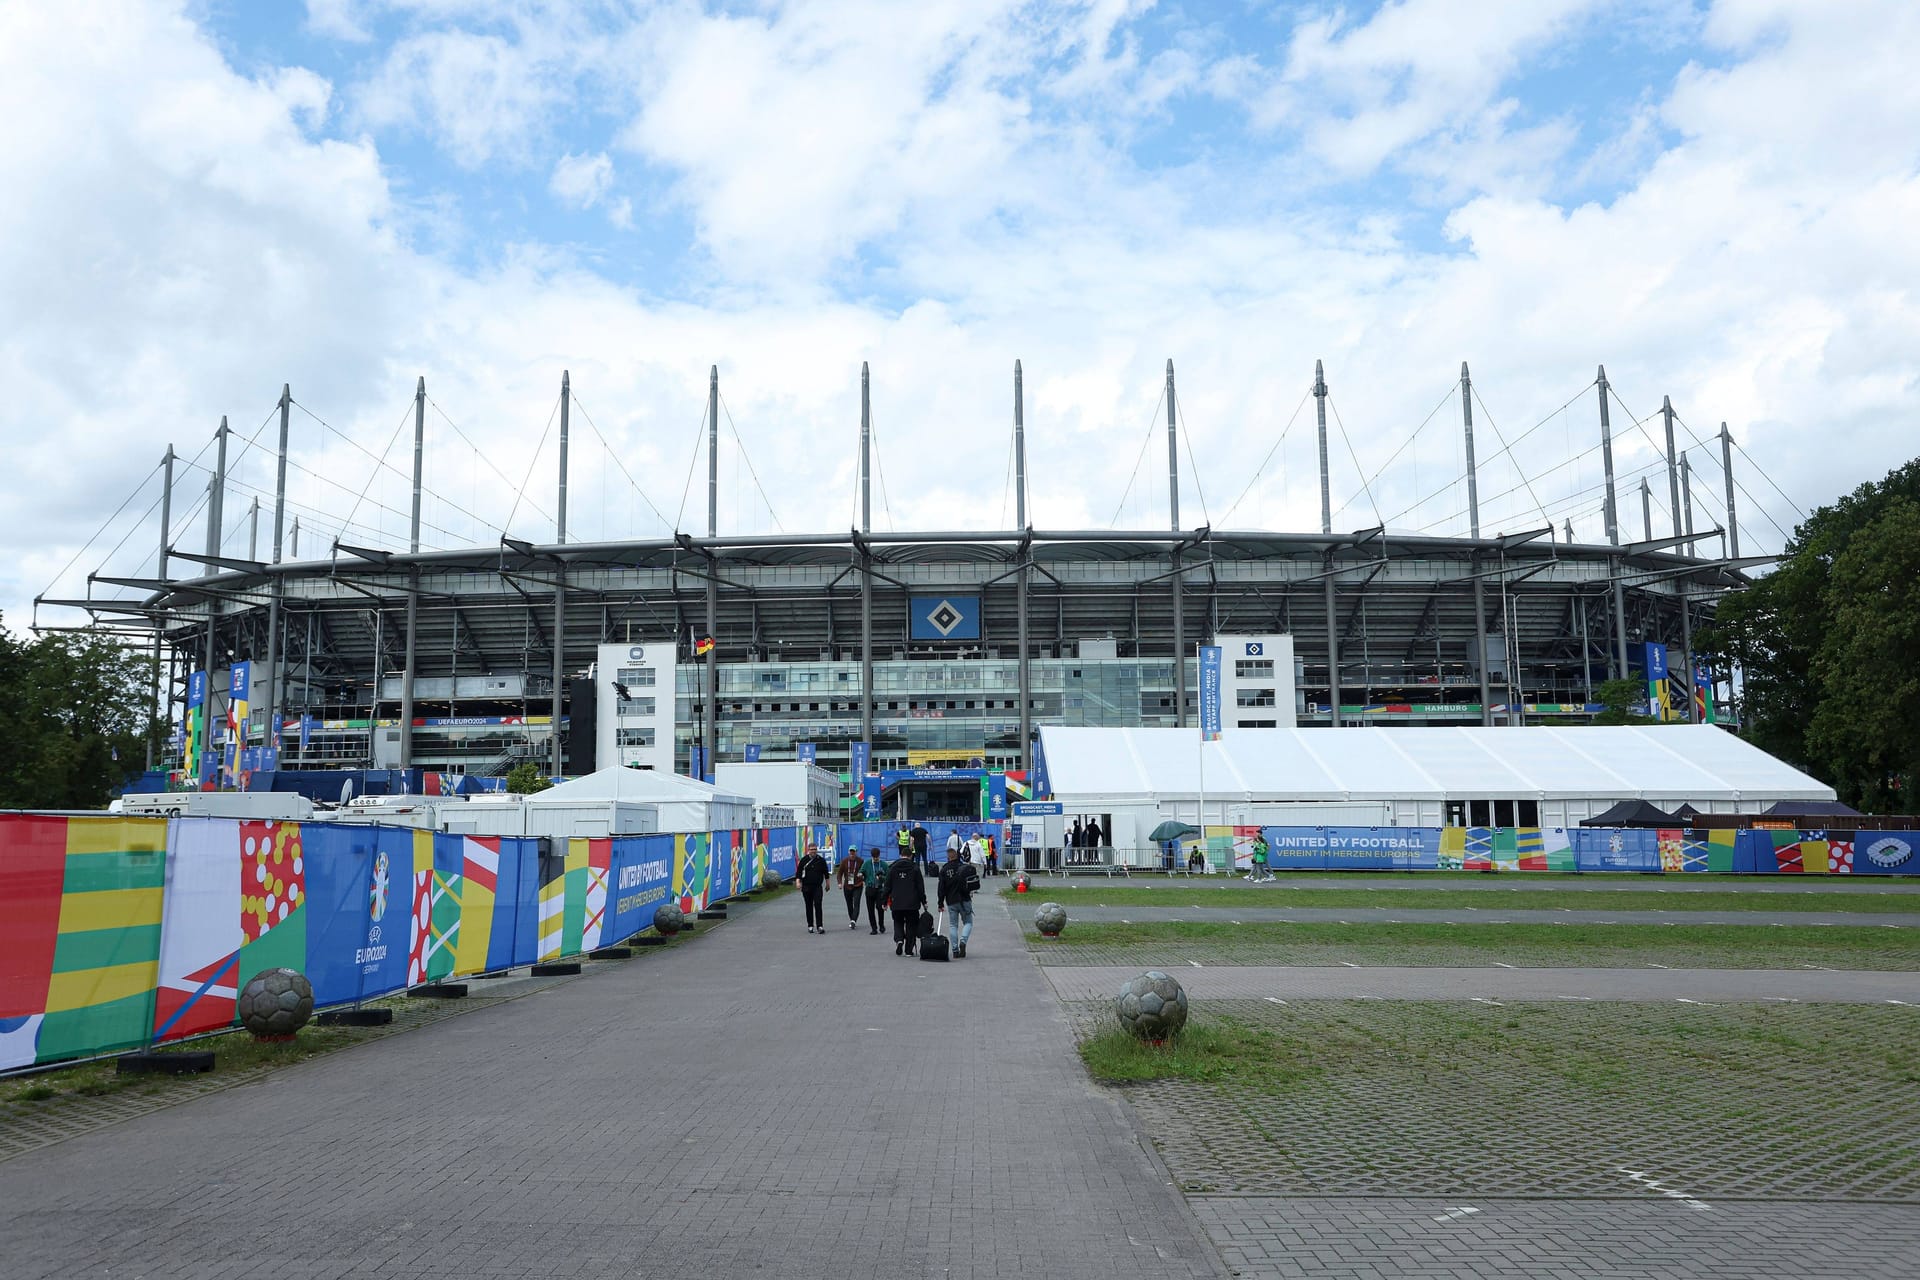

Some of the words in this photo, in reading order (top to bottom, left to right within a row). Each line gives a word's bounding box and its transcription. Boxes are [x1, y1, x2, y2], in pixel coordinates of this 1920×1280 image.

[1275, 837, 1327, 848] UNITED
[1329, 837, 1349, 848] BY
[1351, 838, 1425, 849] FOOTBALL
[1276, 849, 1317, 857] VEREINT
[1333, 850, 1372, 858] HERZEN
[1375, 850, 1421, 858] EUROPAS
[643, 859, 668, 883] FOOTBALL
[355, 945, 387, 964] EURO2024
